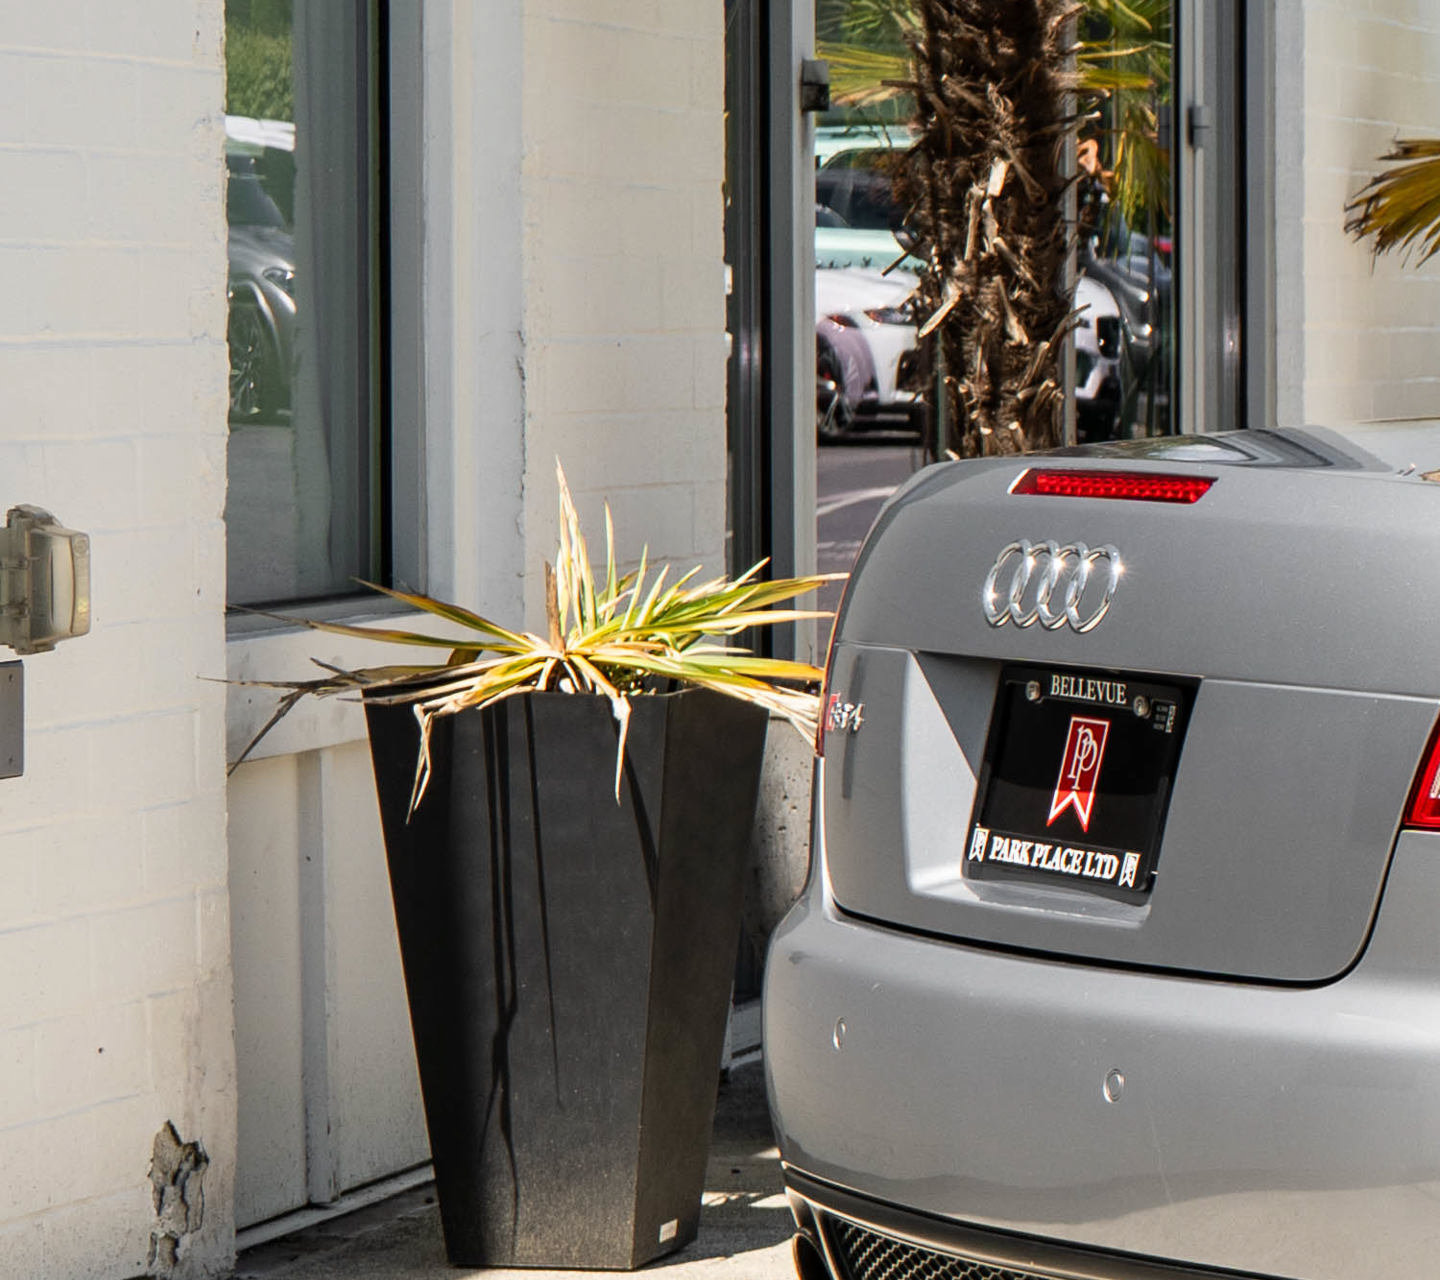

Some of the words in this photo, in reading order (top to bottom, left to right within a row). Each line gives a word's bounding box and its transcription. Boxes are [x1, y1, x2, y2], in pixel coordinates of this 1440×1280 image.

[1050, 674, 1126, 704] BELLEVUE
[989, 836, 1034, 866] PARK
[1031, 843, 1086, 874] PLACE
[1083, 851, 1119, 879] LTD
